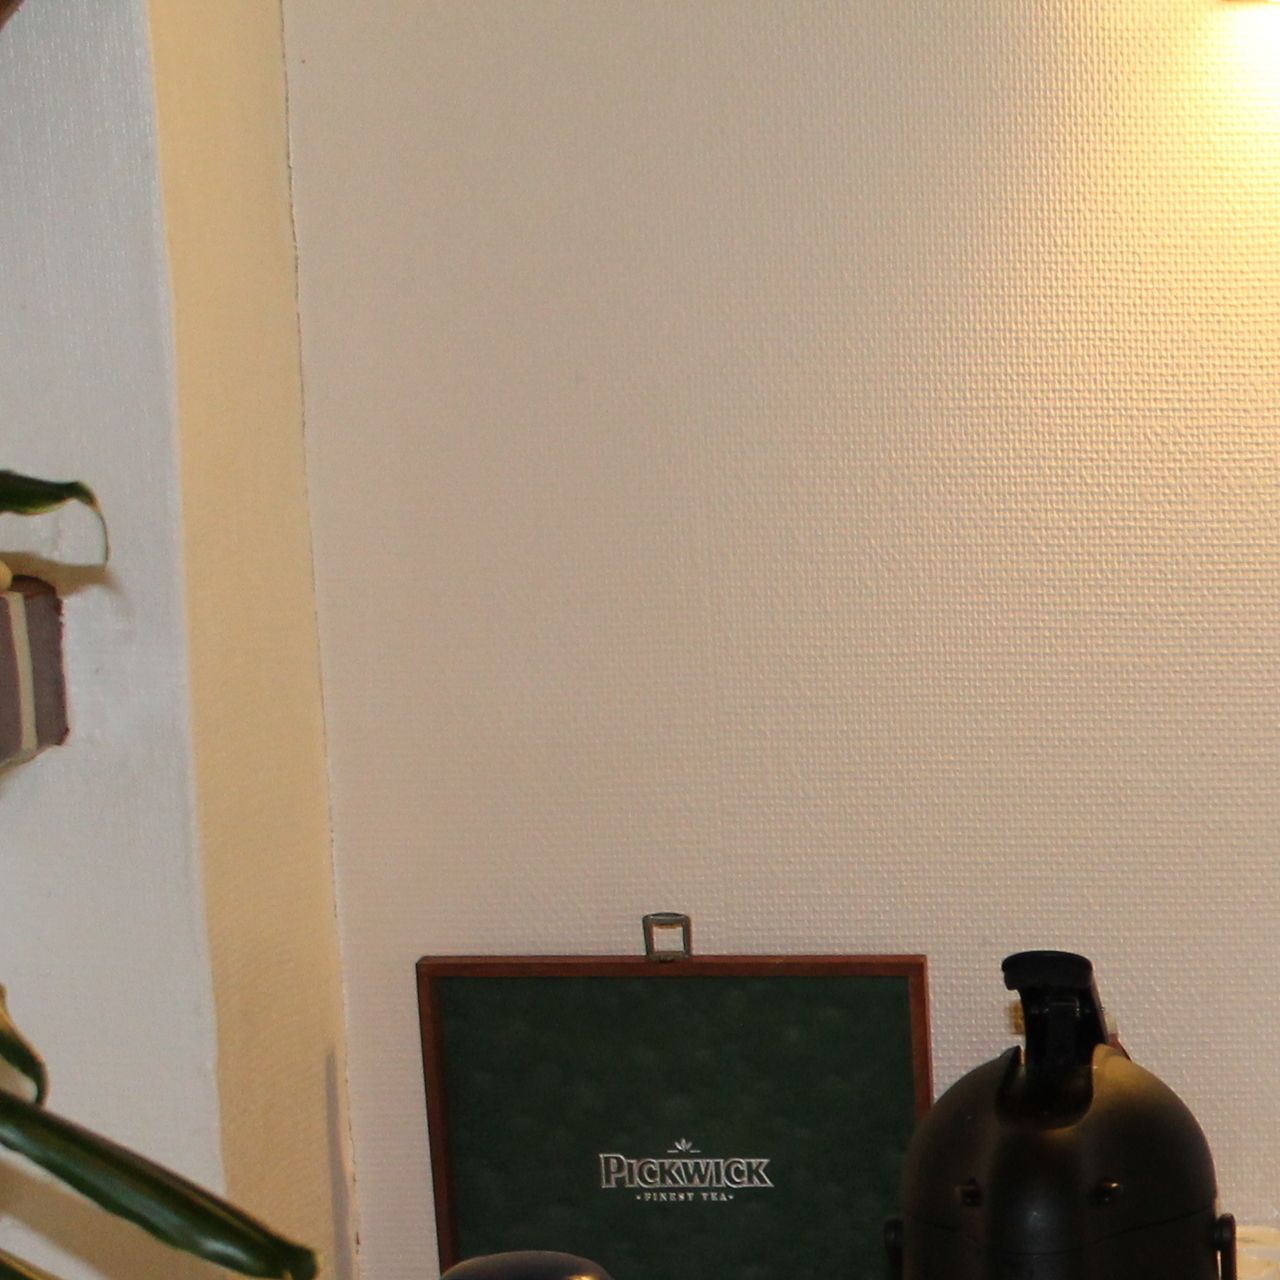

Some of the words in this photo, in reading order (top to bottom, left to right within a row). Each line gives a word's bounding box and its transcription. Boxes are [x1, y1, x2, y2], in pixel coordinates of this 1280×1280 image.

[599, 1153, 774, 1188] PICKWICK
[643, 1192, 695, 1202] FINEST
[701, 1192, 728, 1202] TEA
